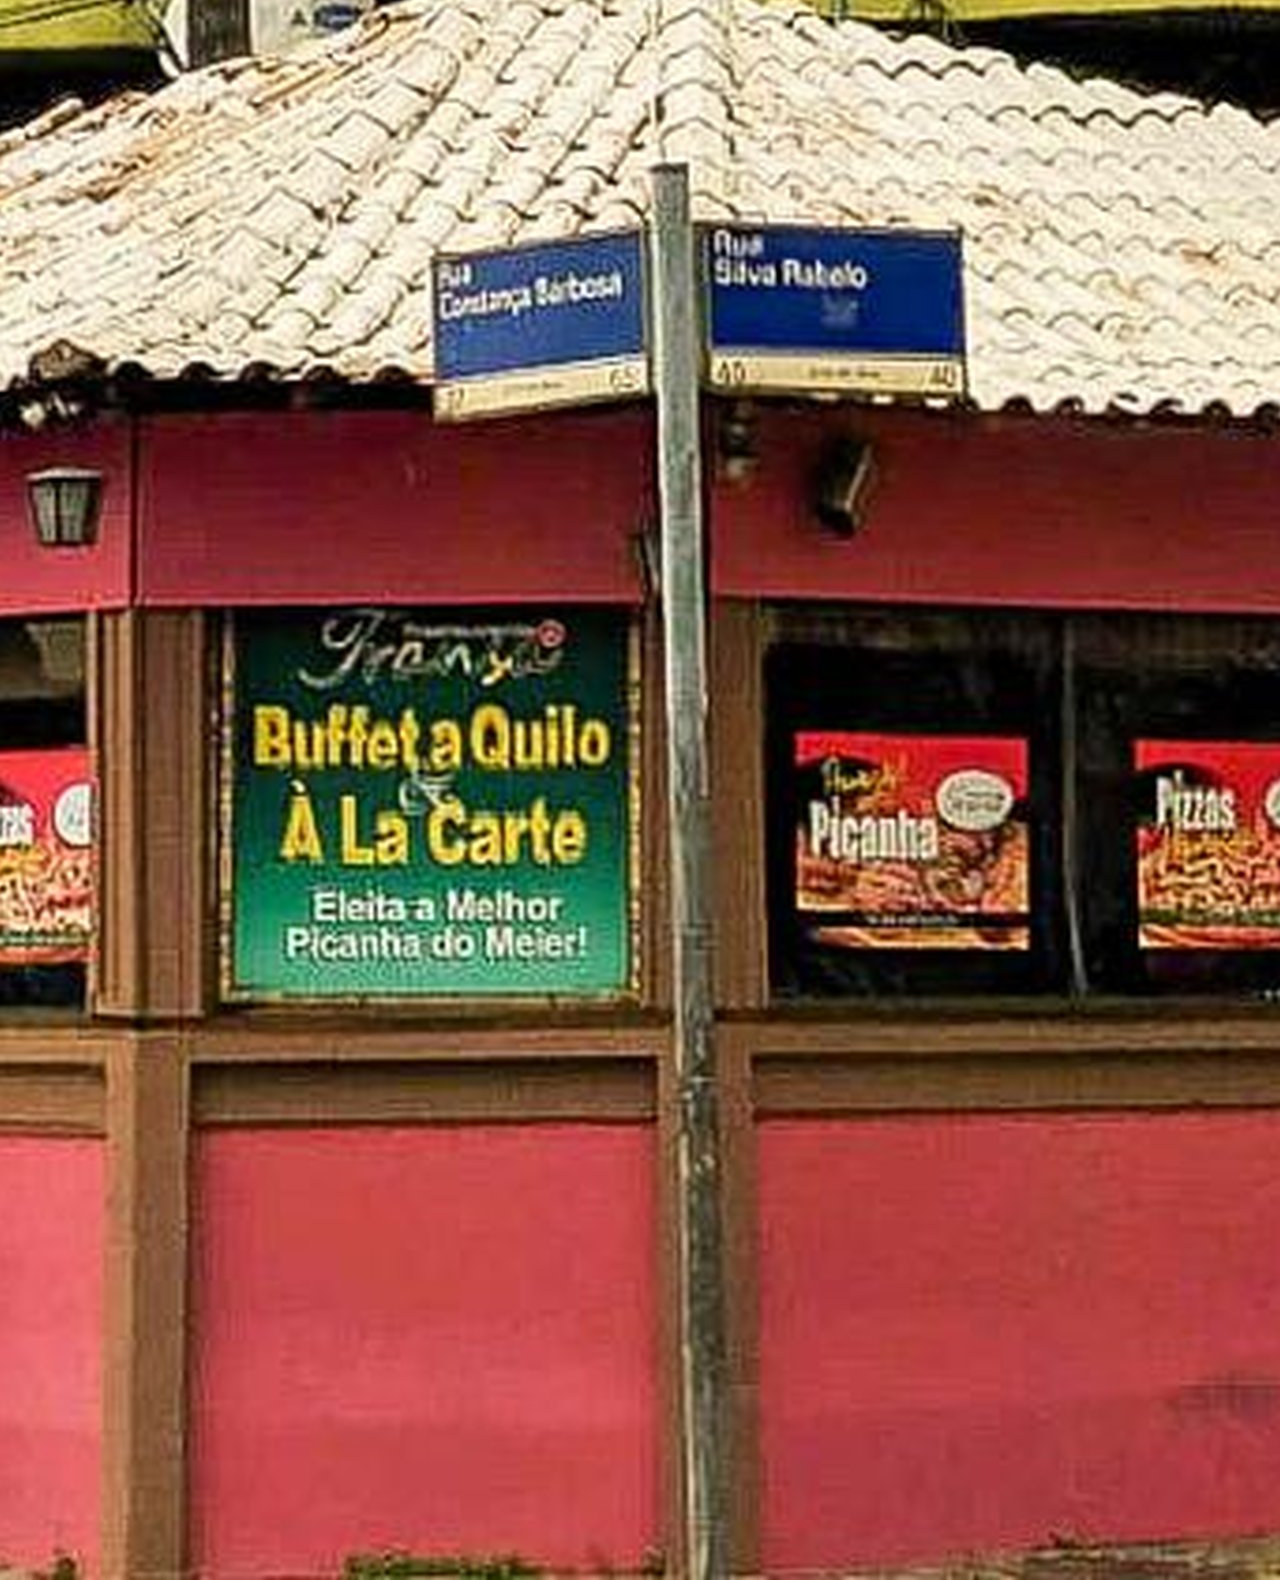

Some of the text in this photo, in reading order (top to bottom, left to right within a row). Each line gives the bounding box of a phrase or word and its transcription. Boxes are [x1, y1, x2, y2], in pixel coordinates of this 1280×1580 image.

[713, 230, 764, 257] Rua
[438, 263, 472, 290] Rua
[713, 258, 778, 286] Silva
[439, 270, 623, 320] Constança Barbosa
[252, 703, 610, 770] Buffet a Quilo
[1156, 769, 1236, 830] Pizzas
[280, 780, 588, 865] À La Carte
[809, 795, 938, 860] Picanha
[313, 889, 562, 922] Eleita a Melhor
[286, 926, 420, 959] Picanha
[431, 926, 475, 959] do
